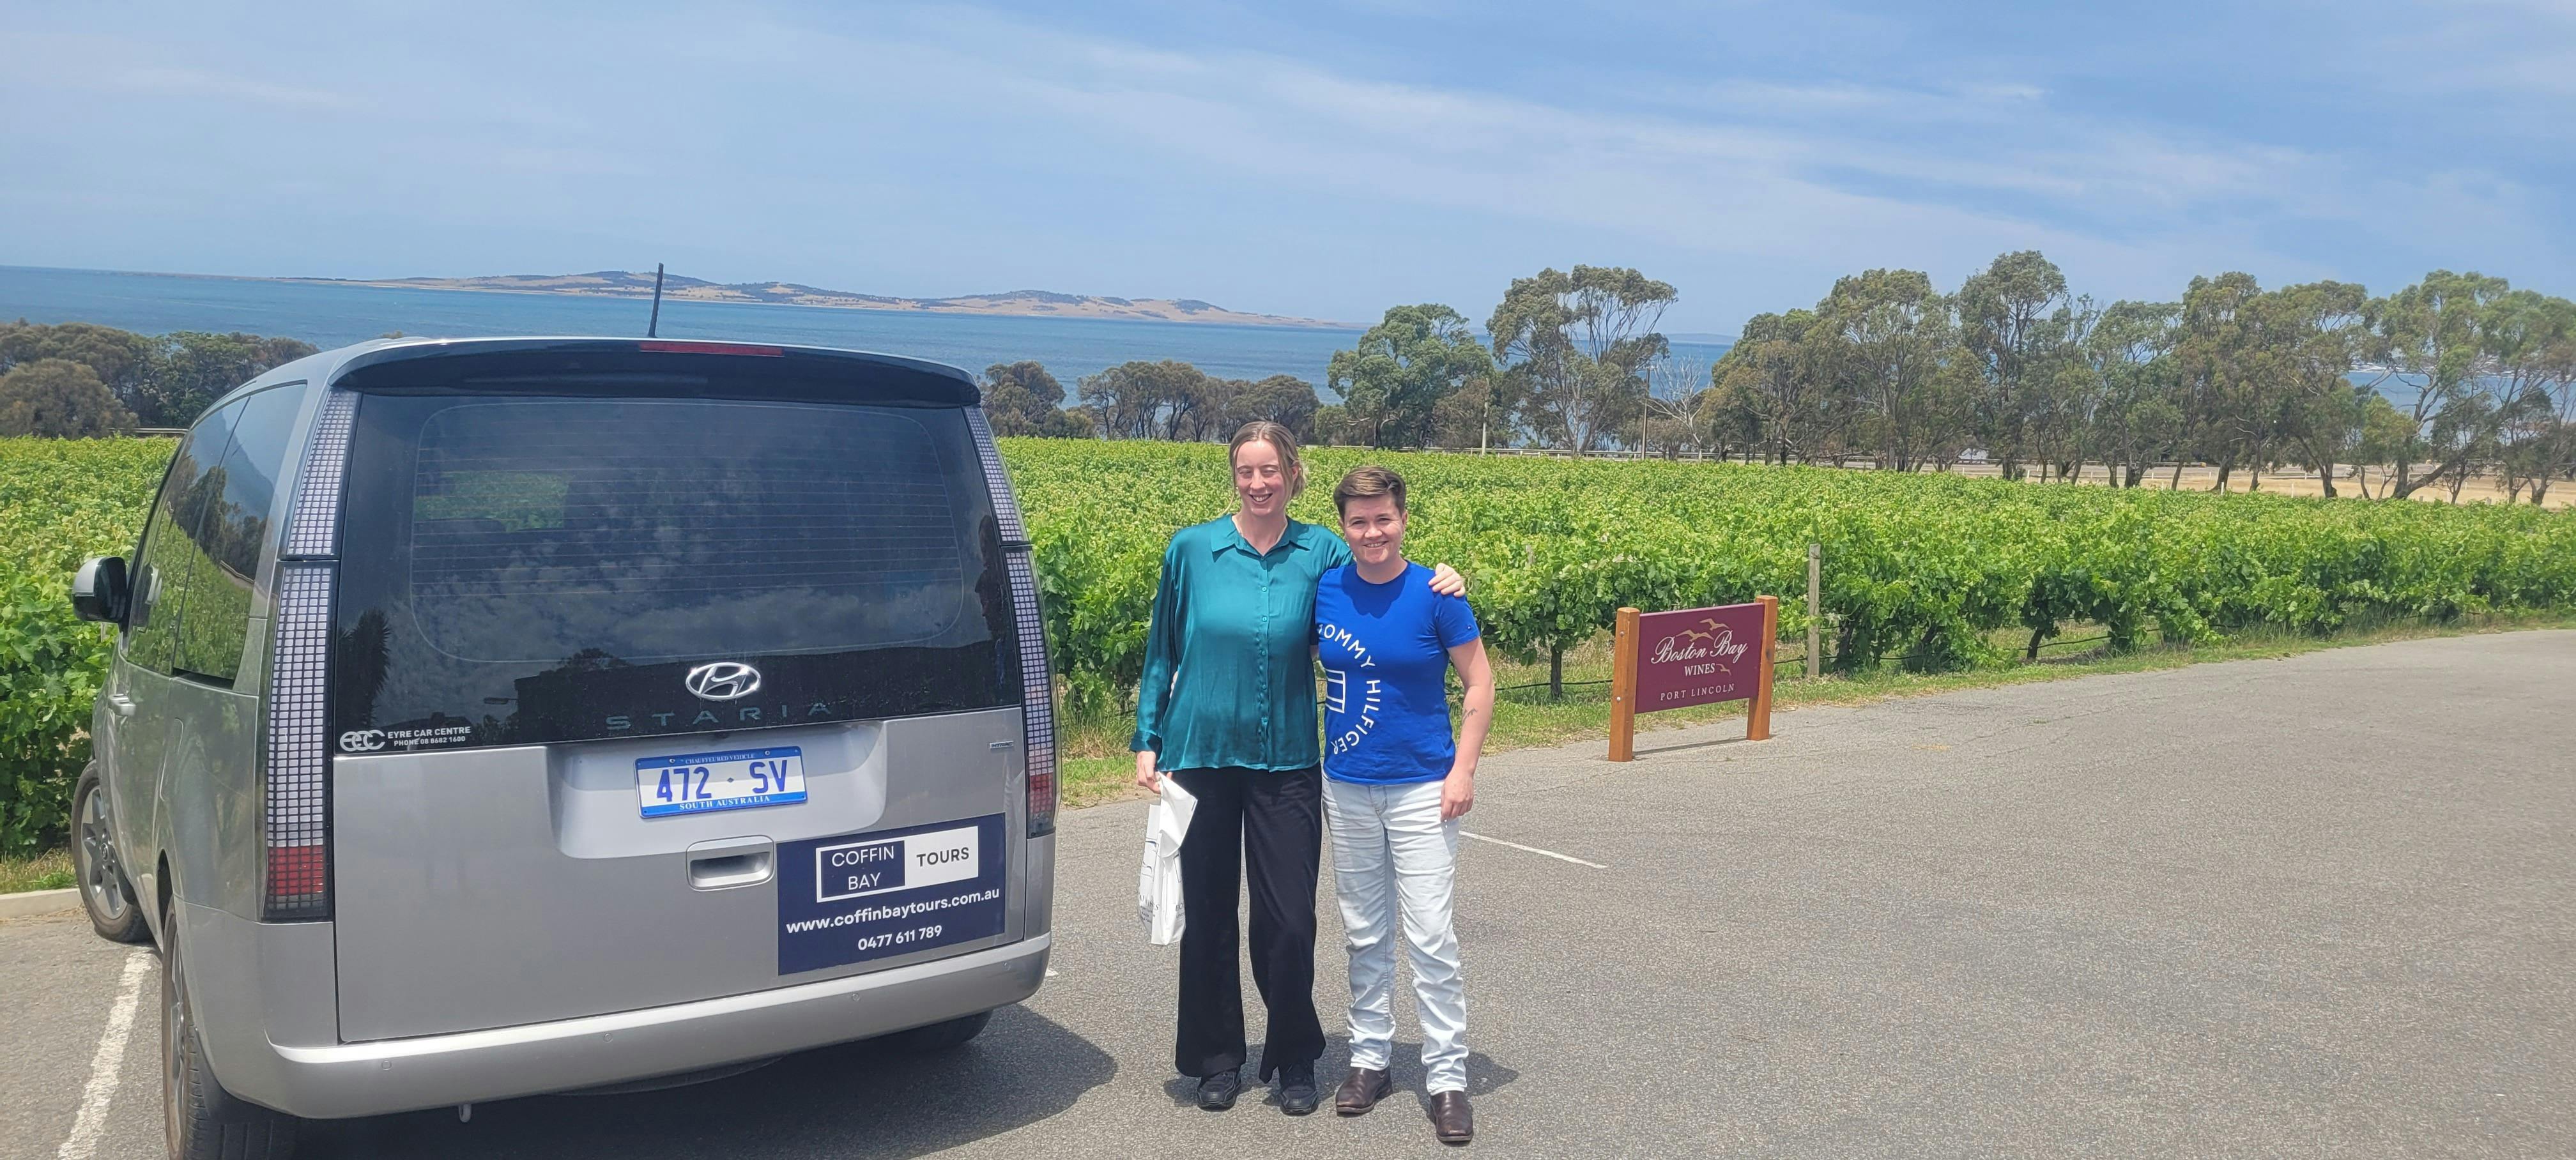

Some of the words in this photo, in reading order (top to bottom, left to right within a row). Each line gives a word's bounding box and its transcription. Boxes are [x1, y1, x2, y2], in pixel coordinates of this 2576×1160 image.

[1651, 636, 1708, 664] Boston
[1710, 630, 1748, 664] Bay
[1684, 662, 1716, 677] WINES
[1660, 689, 1687, 701] PORT
[1691, 683, 1735, 697] LINCOLN
[606, 702, 831, 730] STARIA
[1330, 680, 1381, 755] HILFIGER
[388, 730, 411, 739] EYRE
[434, 726, 471, 735] CENTRE
[394, 738, 418, 747] PHONE
[686, 755, 729, 765] CHAUFFEURED
[656, 767, 712, 802] 472
[749, 759, 788, 794] SV
[679, 800, 714, 810] SOUTH
[716, 796, 770, 807] AUSTRALIA
[832, 845, 894, 867] COFFIN
[916, 847, 969, 867] TOURS
[848, 872, 881, 890] BAY
[786, 888, 1000, 934] www.coffinbaytours.com.au
[857, 933, 893, 951] 0477
[895, 929, 916, 945] 611
[918, 925, 942, 941] 789
